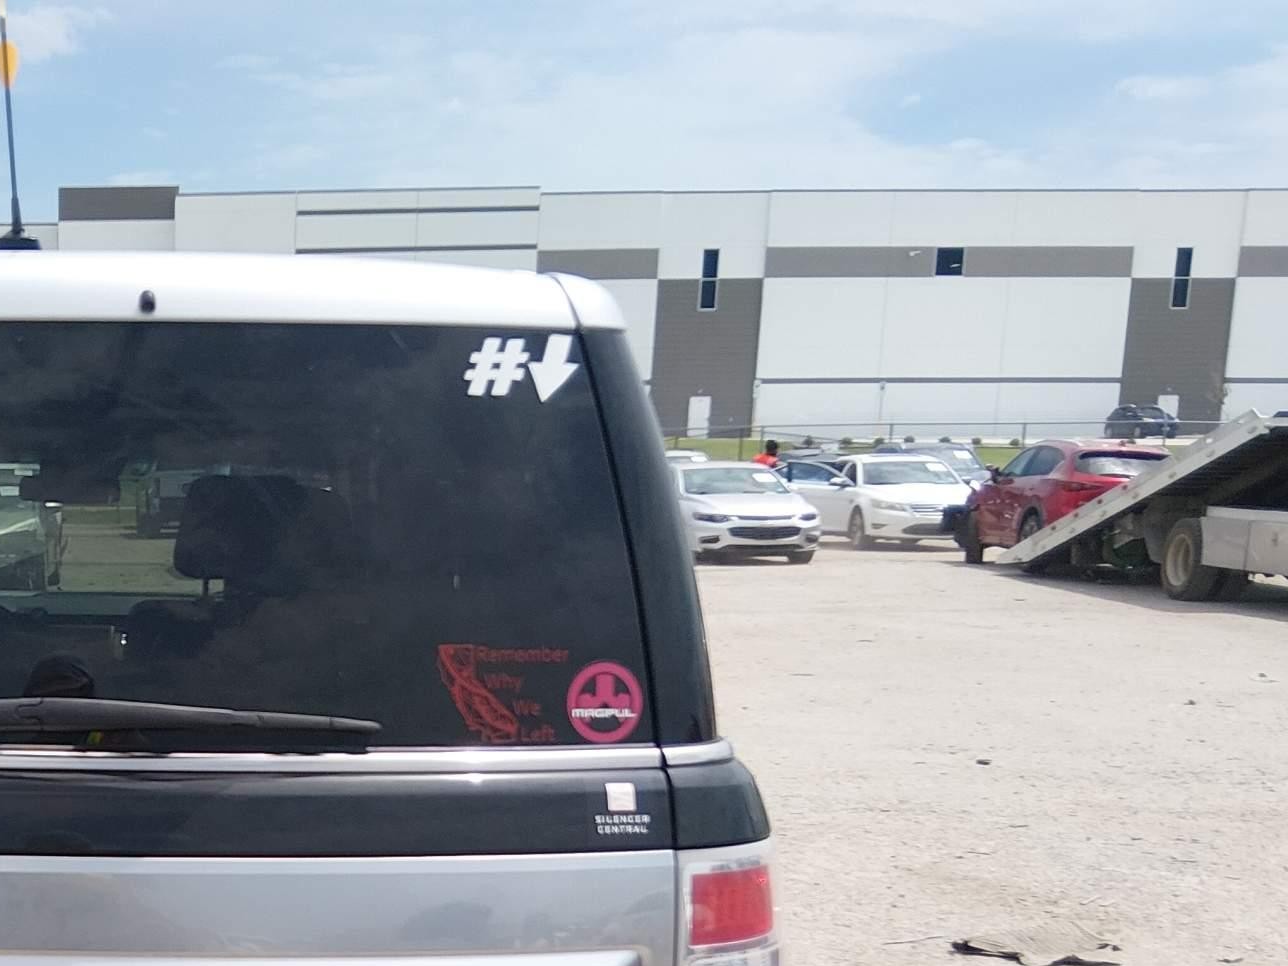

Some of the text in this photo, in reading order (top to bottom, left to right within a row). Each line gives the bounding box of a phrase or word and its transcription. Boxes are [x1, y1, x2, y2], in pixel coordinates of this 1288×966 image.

[478, 645, 569, 662] Remember
[571, 707, 637, 718] MAGPUL
[594, 814, 651, 824] SILENCER
[596, 824, 649, 835] CENTRAL
